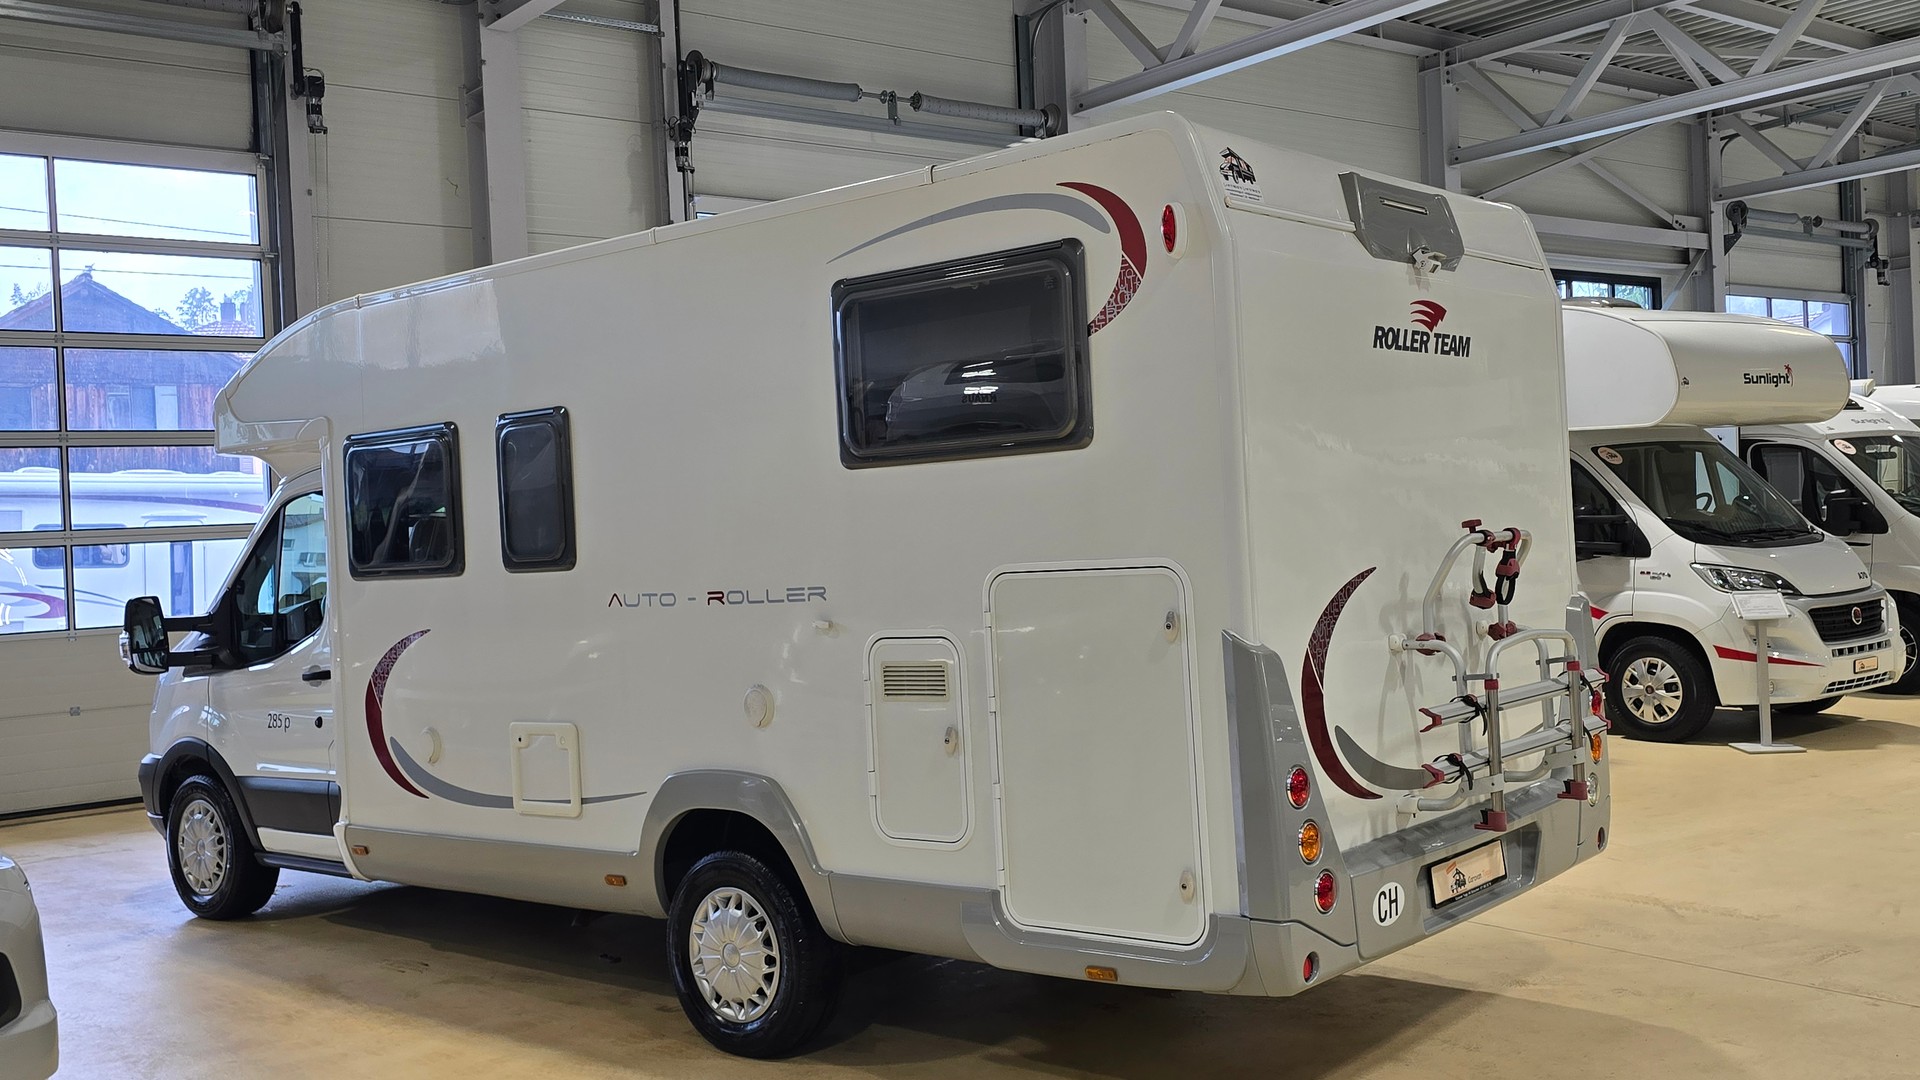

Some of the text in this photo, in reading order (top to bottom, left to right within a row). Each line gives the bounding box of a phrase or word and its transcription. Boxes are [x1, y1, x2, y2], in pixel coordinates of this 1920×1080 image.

[1373, 325, 1472, 358] ROLLER TEAM
[1743, 372, 1791, 388] Sunlight
[608, 592, 677, 608] AUTO
[706, 586, 827, 606] ROLLER
[267, 713, 291, 733] 285 p
[1378, 886, 1399, 923] CH
